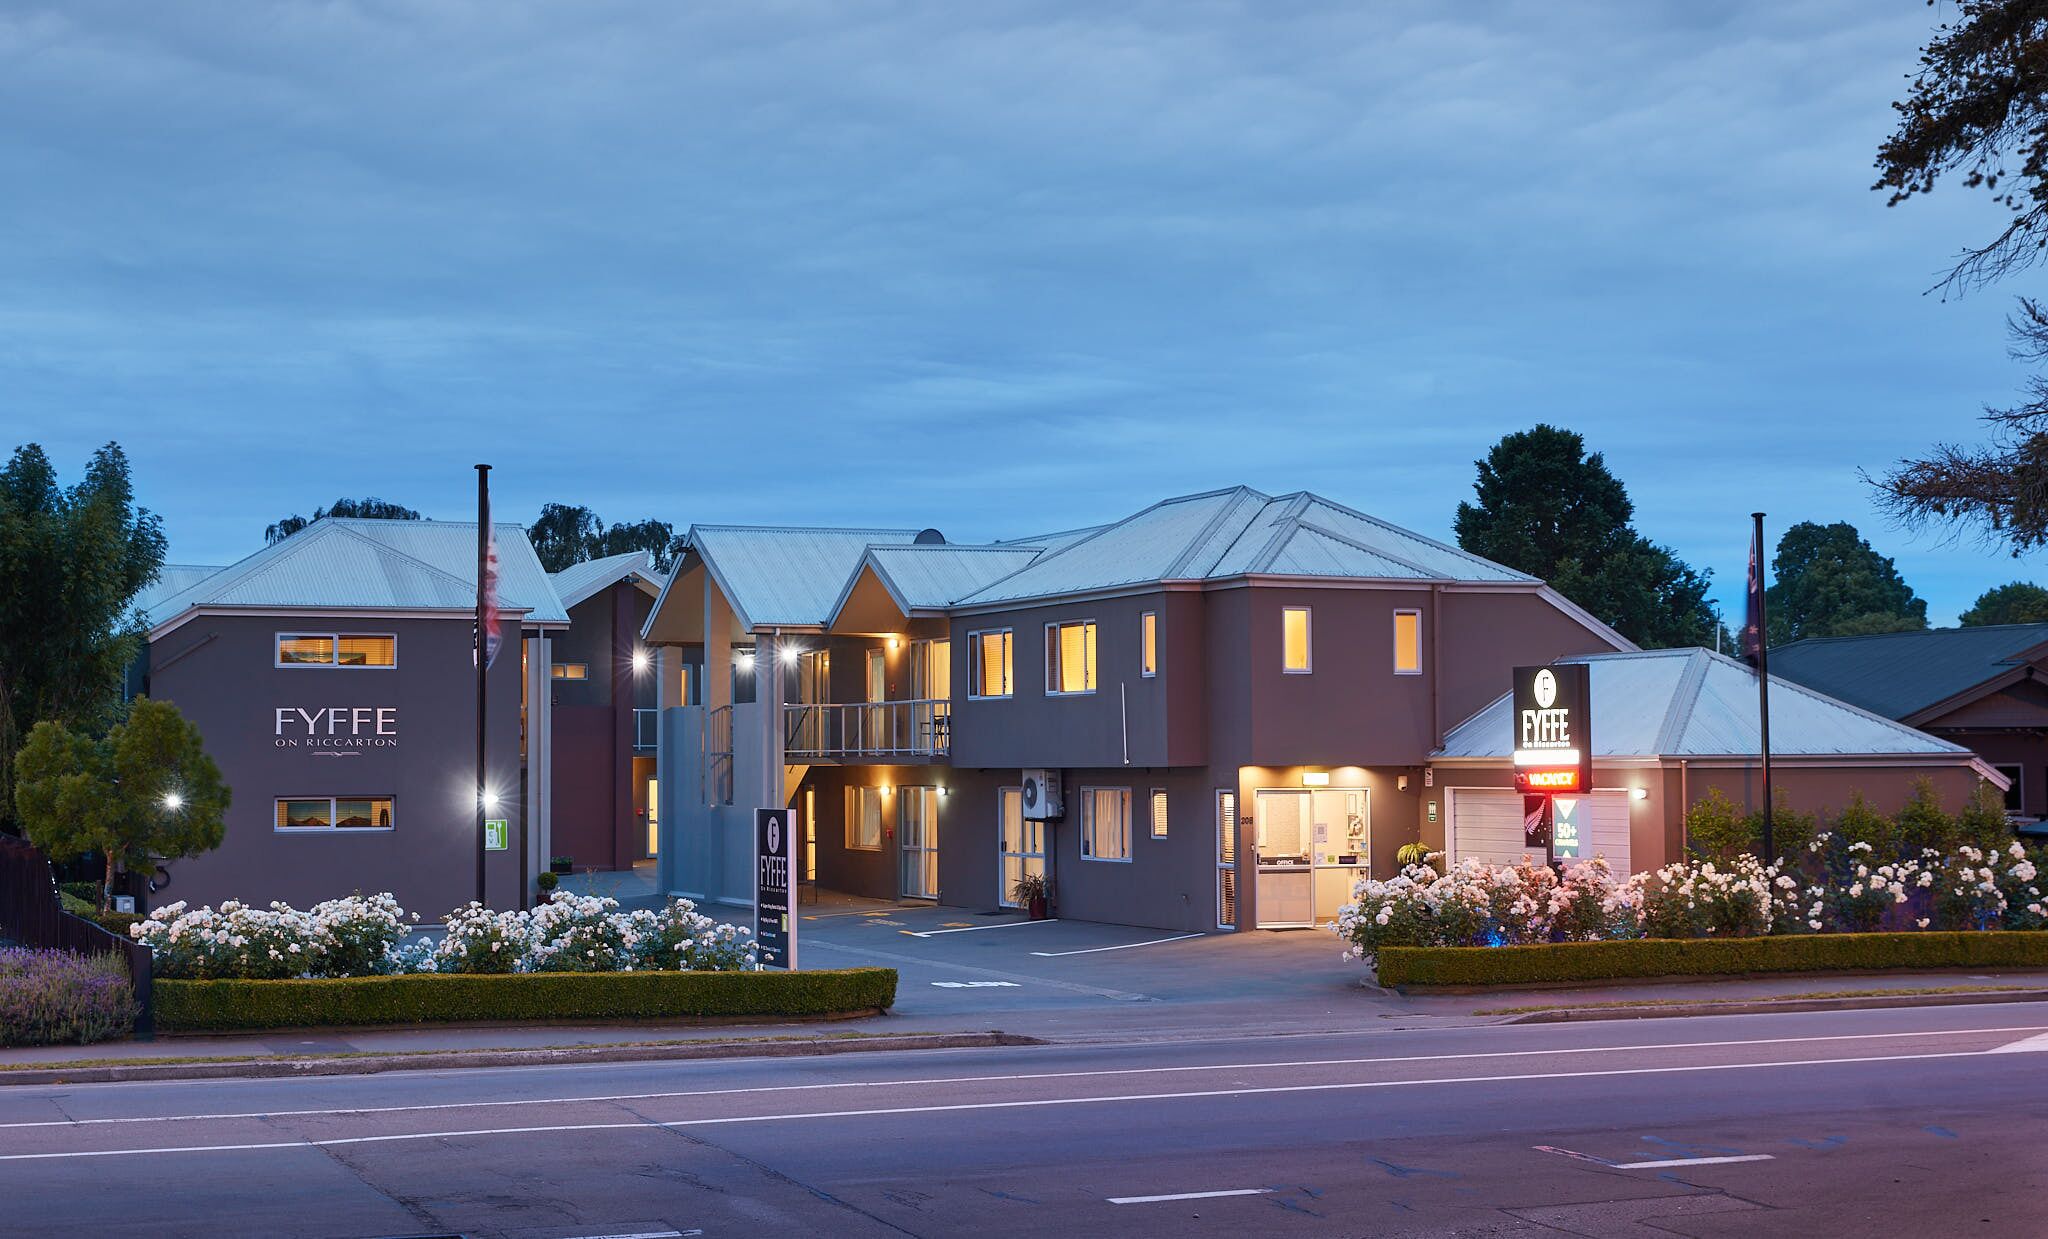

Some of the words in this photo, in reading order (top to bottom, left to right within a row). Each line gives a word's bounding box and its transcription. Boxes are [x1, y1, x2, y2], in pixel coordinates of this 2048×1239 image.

[275, 708, 397, 735] FYFFE
[1522, 709, 1570, 742] FYFFE
[275, 738, 298, 747] ON
[306, 738, 397, 747] RICCARTON
[1529, 772, 1574, 786] VACANCY
[1557, 823, 1577, 838] 50+
[761, 855, 787, 887] FYFFE
